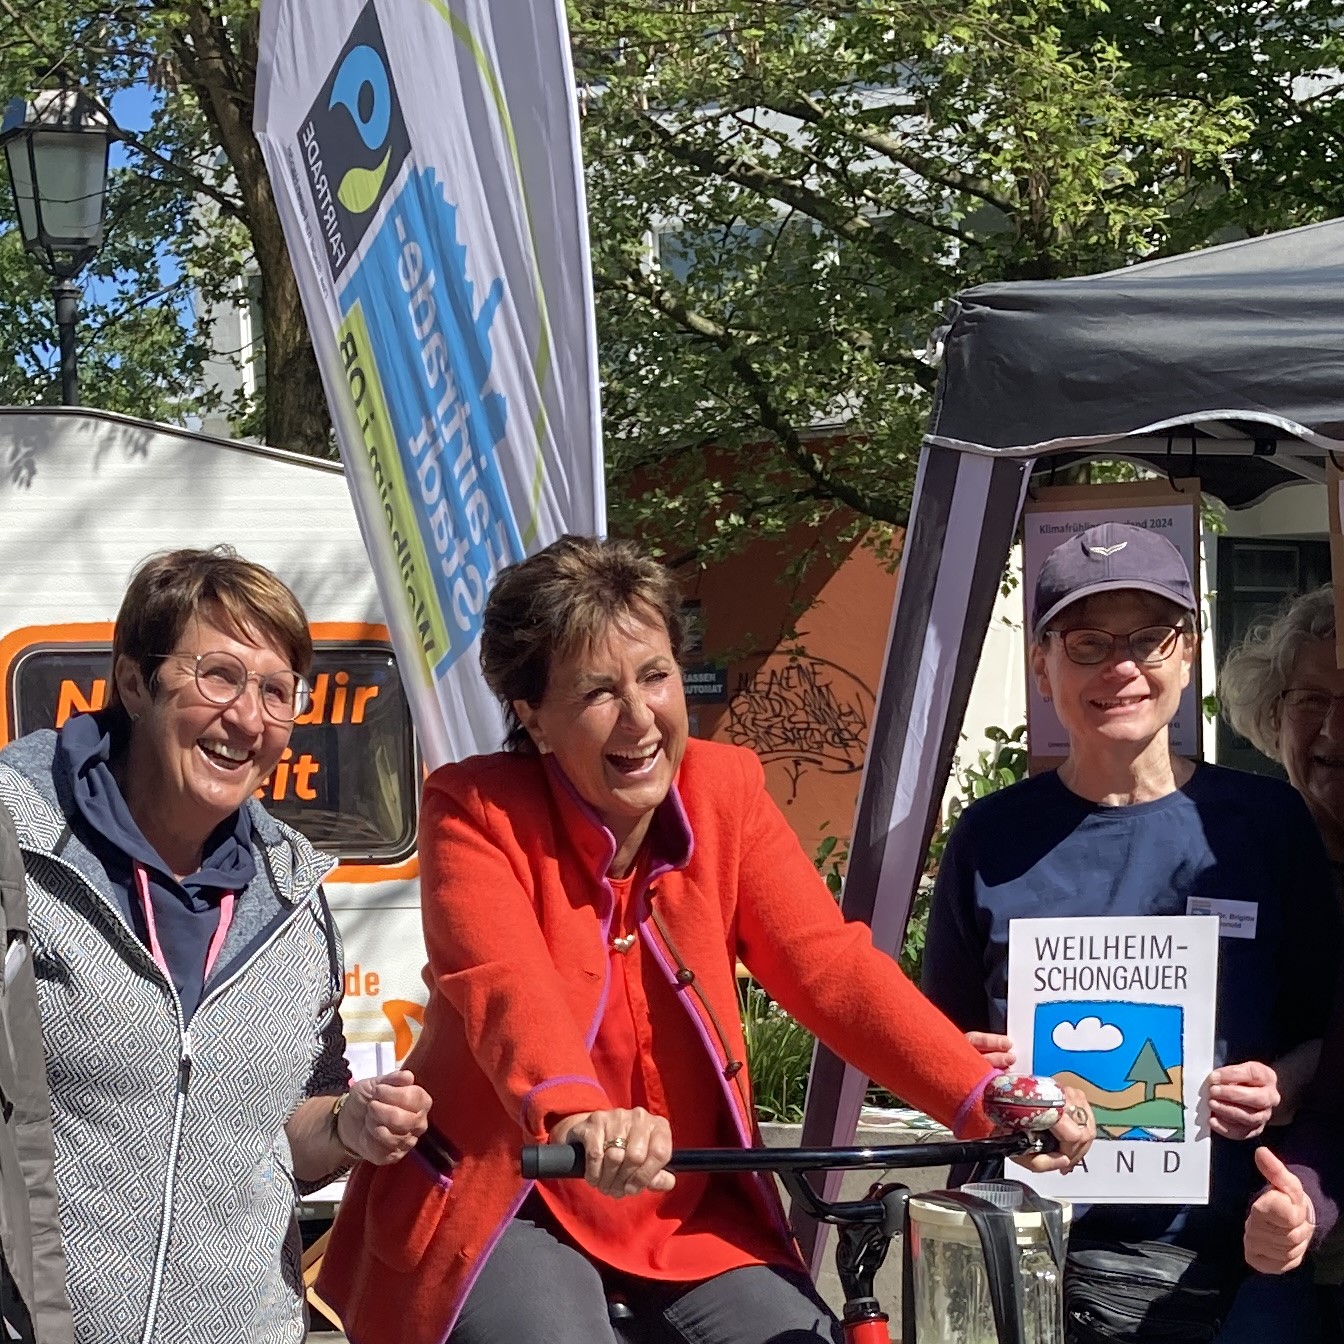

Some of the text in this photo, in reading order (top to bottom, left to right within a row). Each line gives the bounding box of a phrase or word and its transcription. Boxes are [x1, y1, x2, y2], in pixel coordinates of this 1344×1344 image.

[1150, 518, 1173, 529] 2024
[1035, 935, 1188, 961] WEILHEIM-
[1034, 965, 1188, 992] SCHONGAUER
